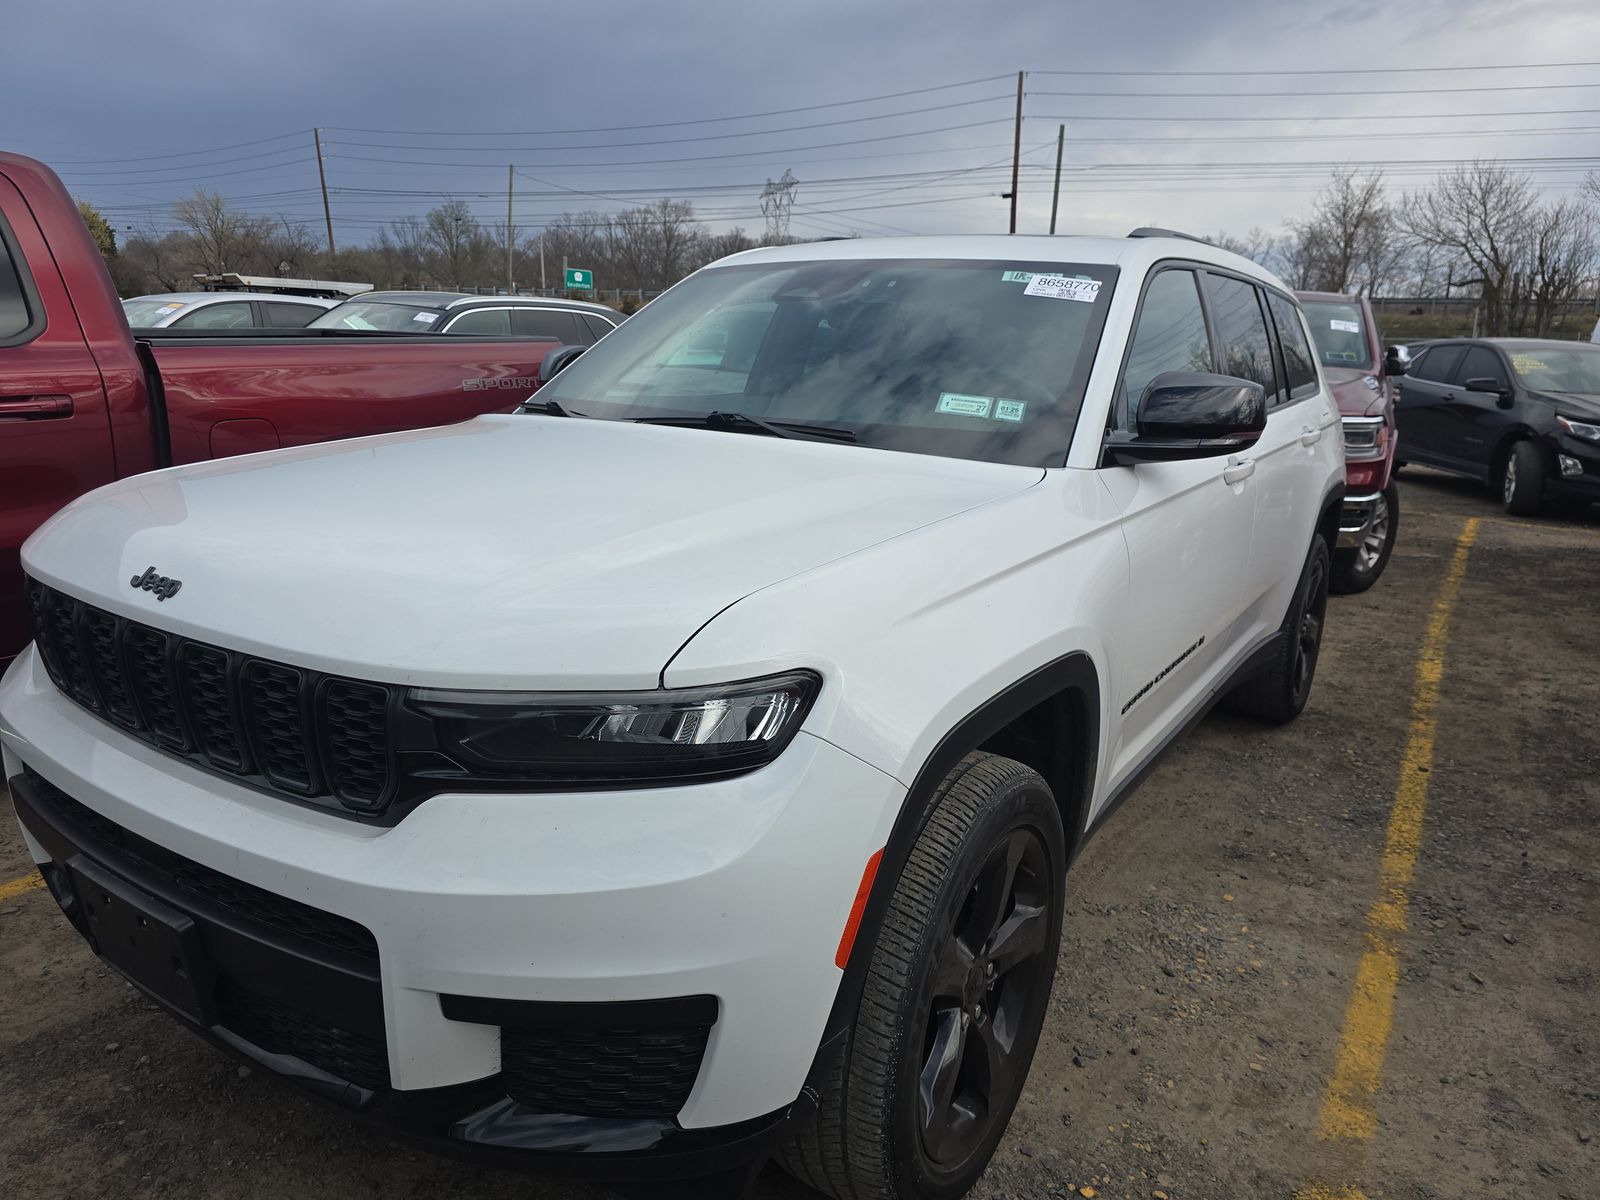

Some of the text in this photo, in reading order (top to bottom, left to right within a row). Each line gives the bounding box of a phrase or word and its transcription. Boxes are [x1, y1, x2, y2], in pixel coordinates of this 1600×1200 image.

[1037, 277, 1101, 292] 8658770
[462, 376, 540, 392] SPORT
[130, 566, 182, 602] Jeep
